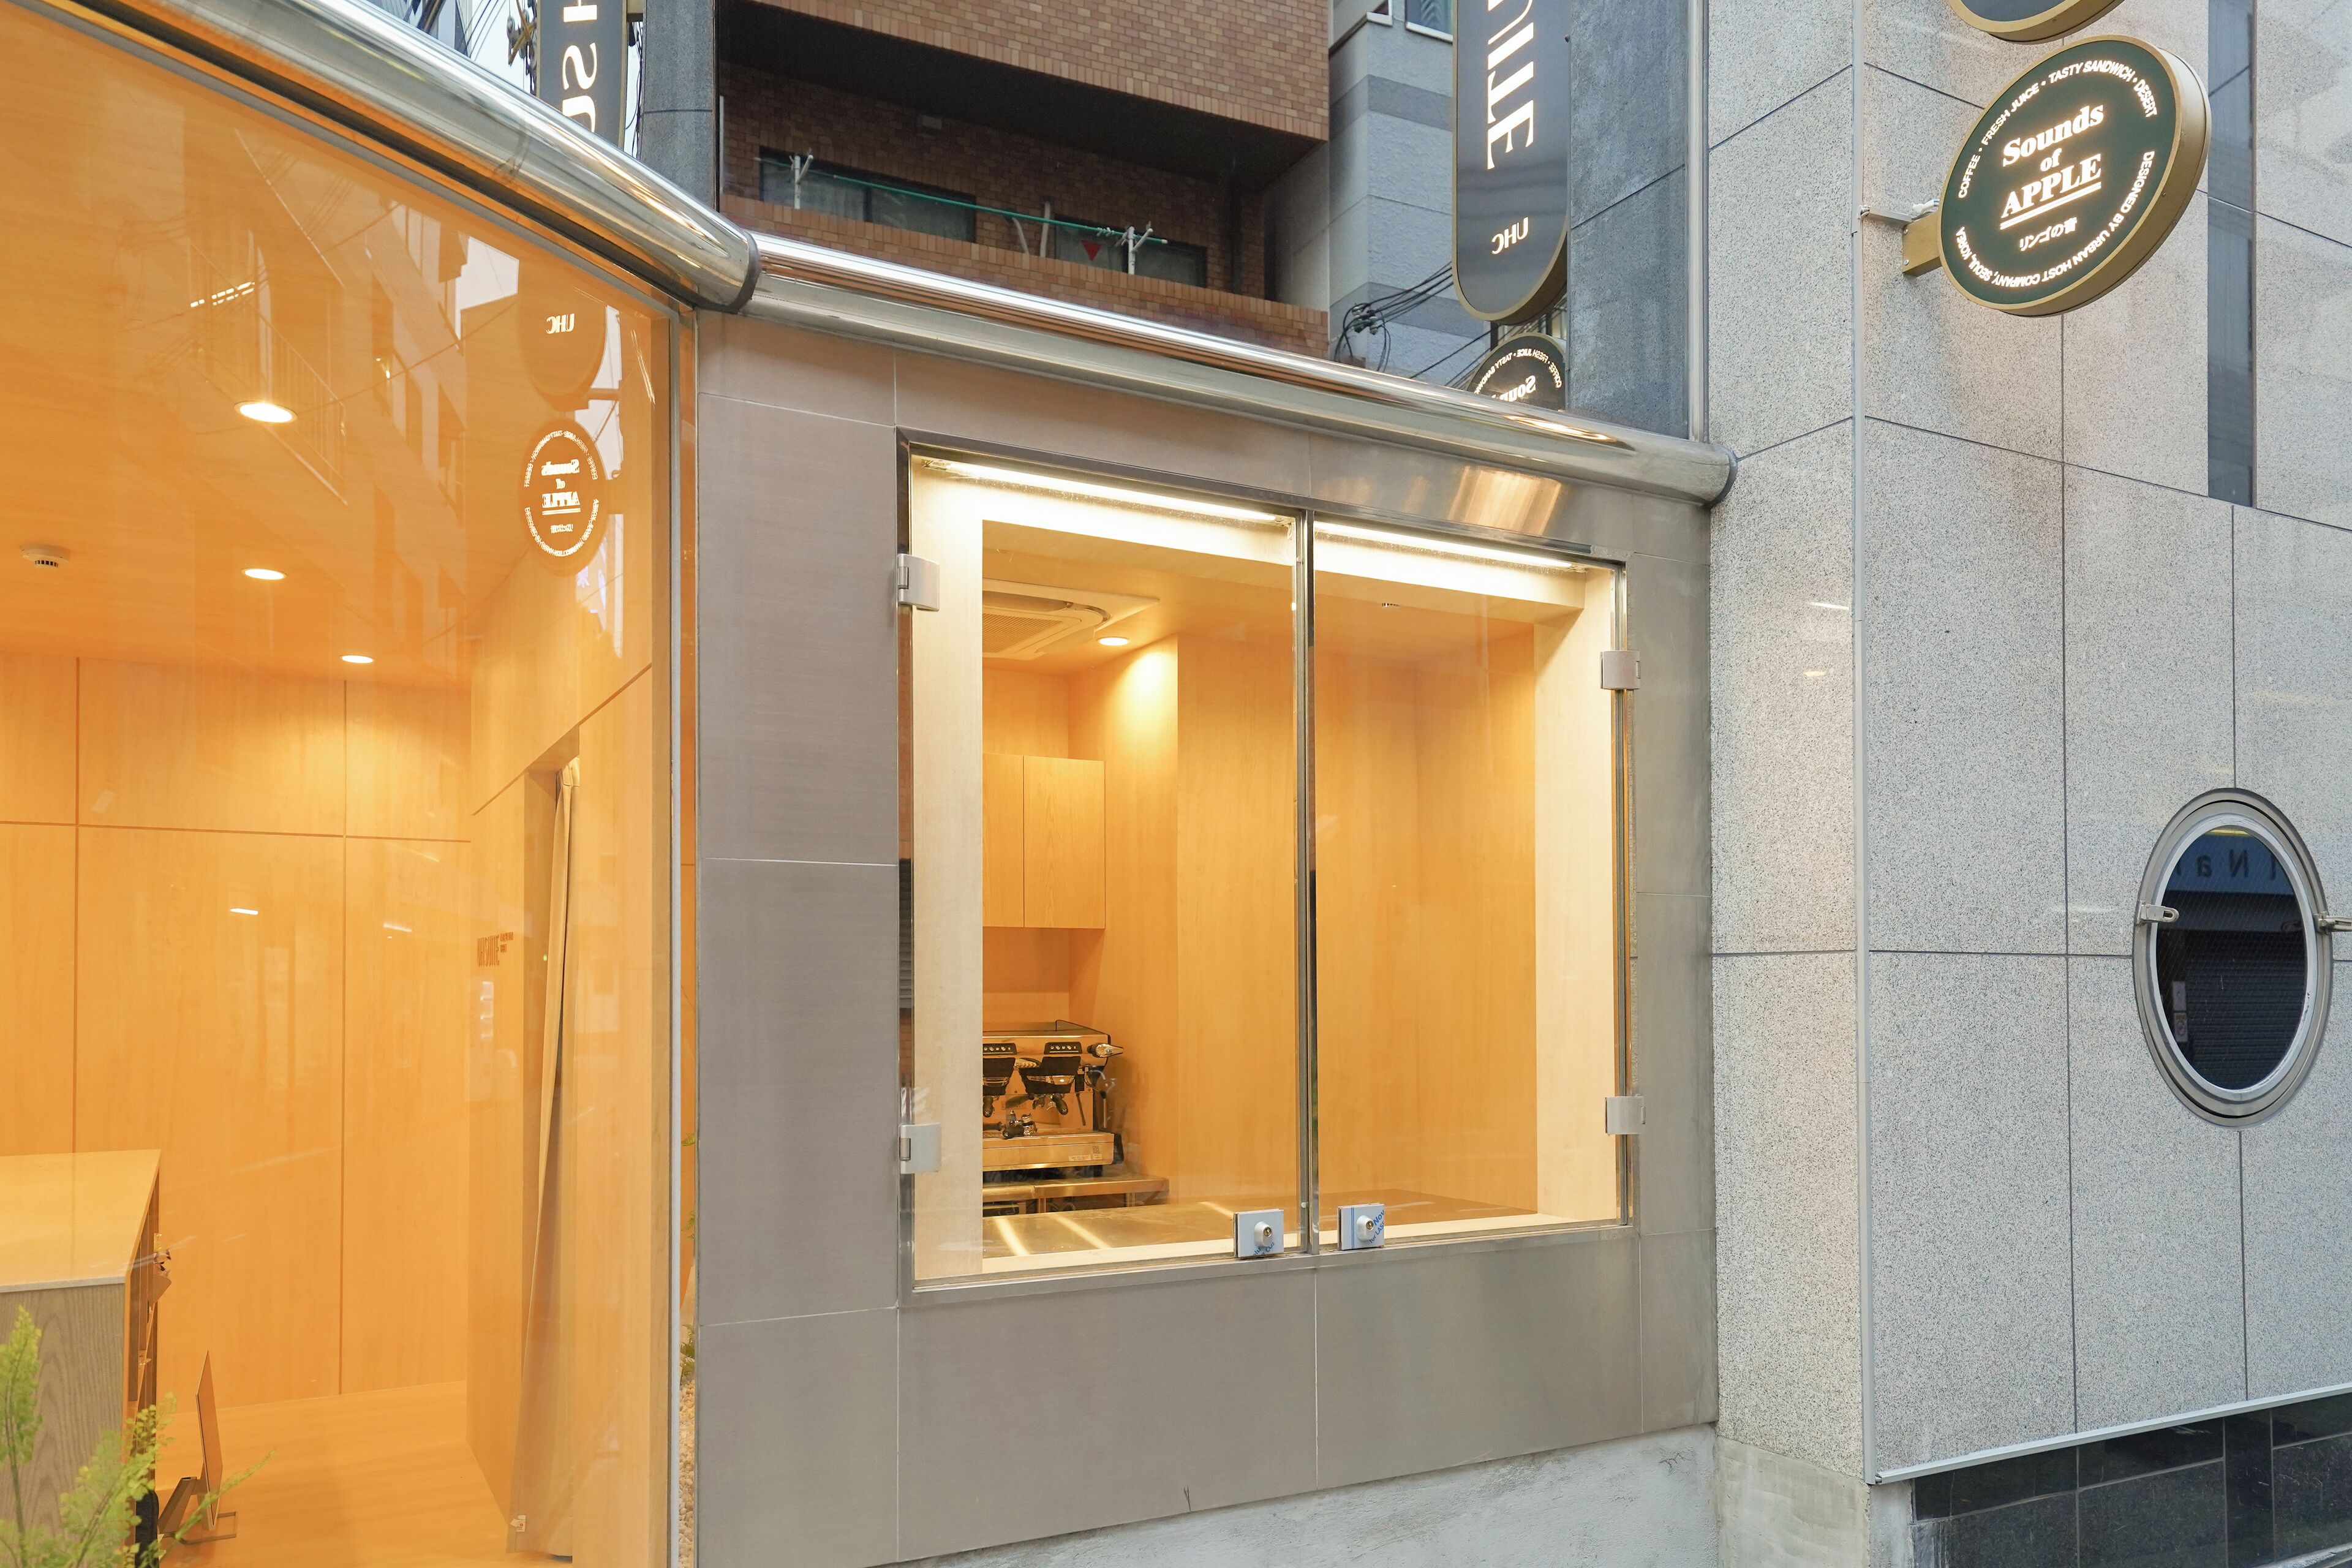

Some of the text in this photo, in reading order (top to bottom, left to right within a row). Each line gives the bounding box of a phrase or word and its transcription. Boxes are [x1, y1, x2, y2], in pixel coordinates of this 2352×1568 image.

[1958, 59, 2158, 198] COFFEE FRESH JUICE TASTY SANDWICH DESERT
[2002, 105, 2105, 167] Sounds
[2040, 148, 2062, 172] of
[2000, 153, 2102, 219] APPLE
[2120, 151, 2155, 213] DESIGNED
[2108, 213, 2125, 232] BY
[1956, 226, 1973, 260] KOREA
[2072, 230, 2111, 265] URBAN
[1991, 271, 2041, 287] COMPANY,
[2041, 259, 2072, 282] HOST
